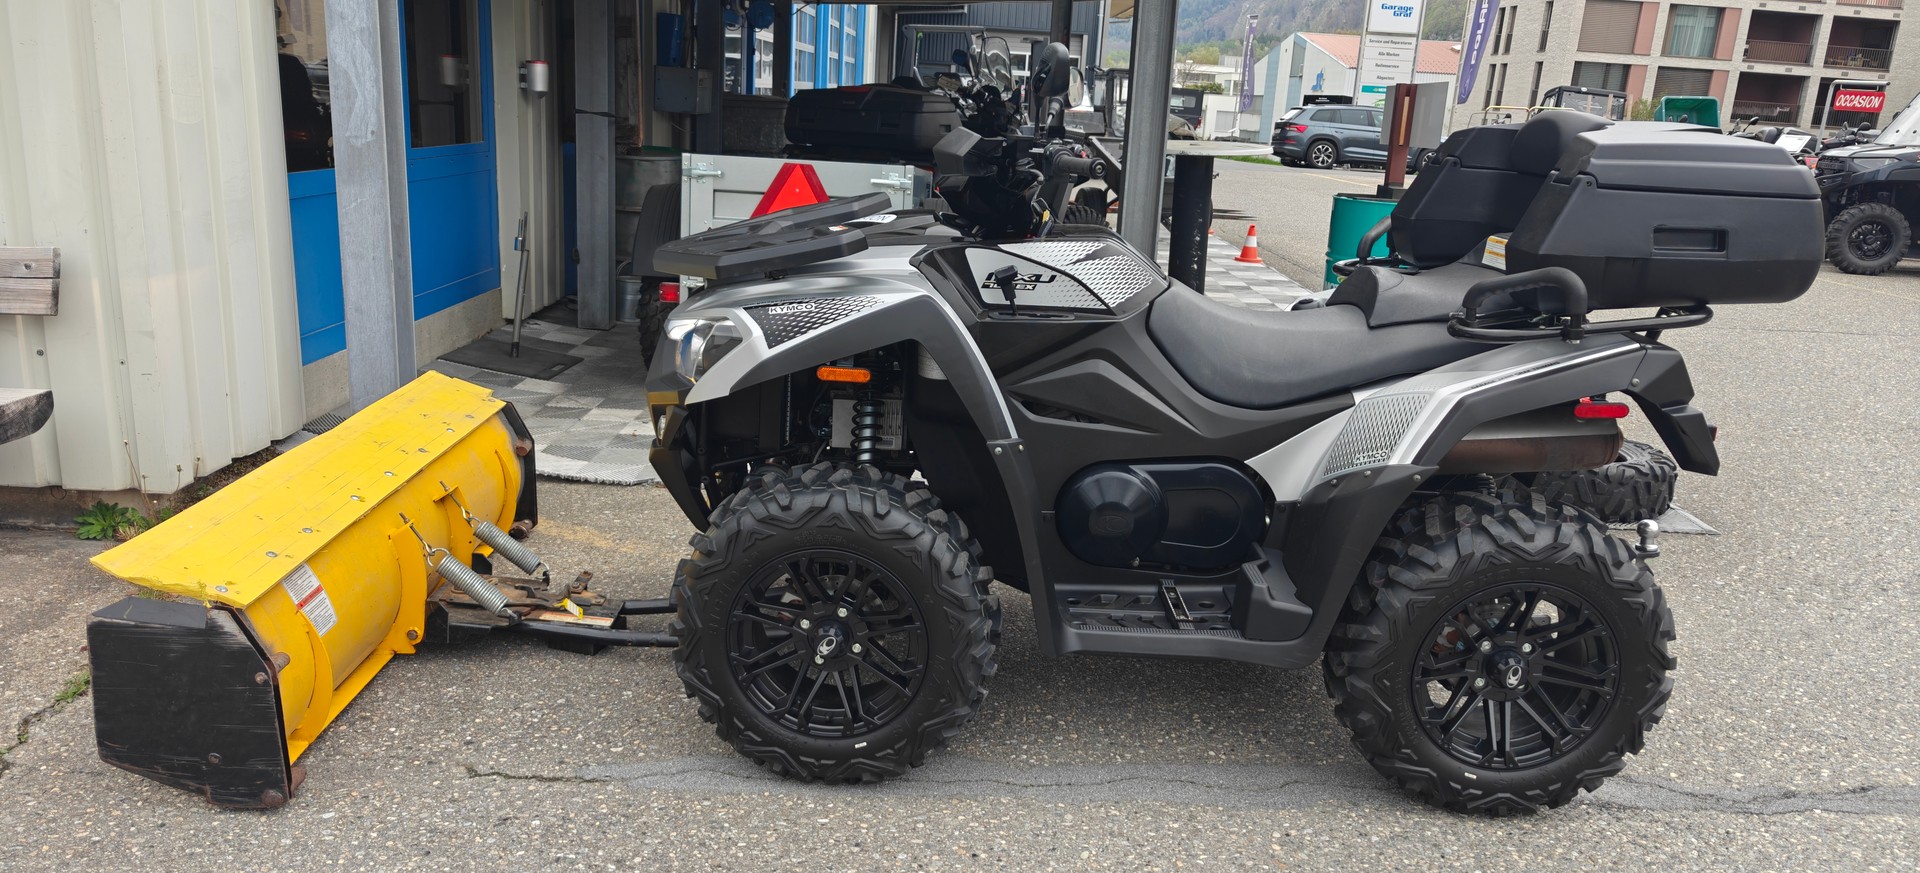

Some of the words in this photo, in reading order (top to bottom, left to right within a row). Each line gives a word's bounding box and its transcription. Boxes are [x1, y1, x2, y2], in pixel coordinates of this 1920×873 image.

[1381, 3, 1414, 12] Garage
[1836, 94, 1883, 108] OCCASION
[770, 304, 814, 314] KYMCO
[1356, 451, 1387, 462] KYMCO
